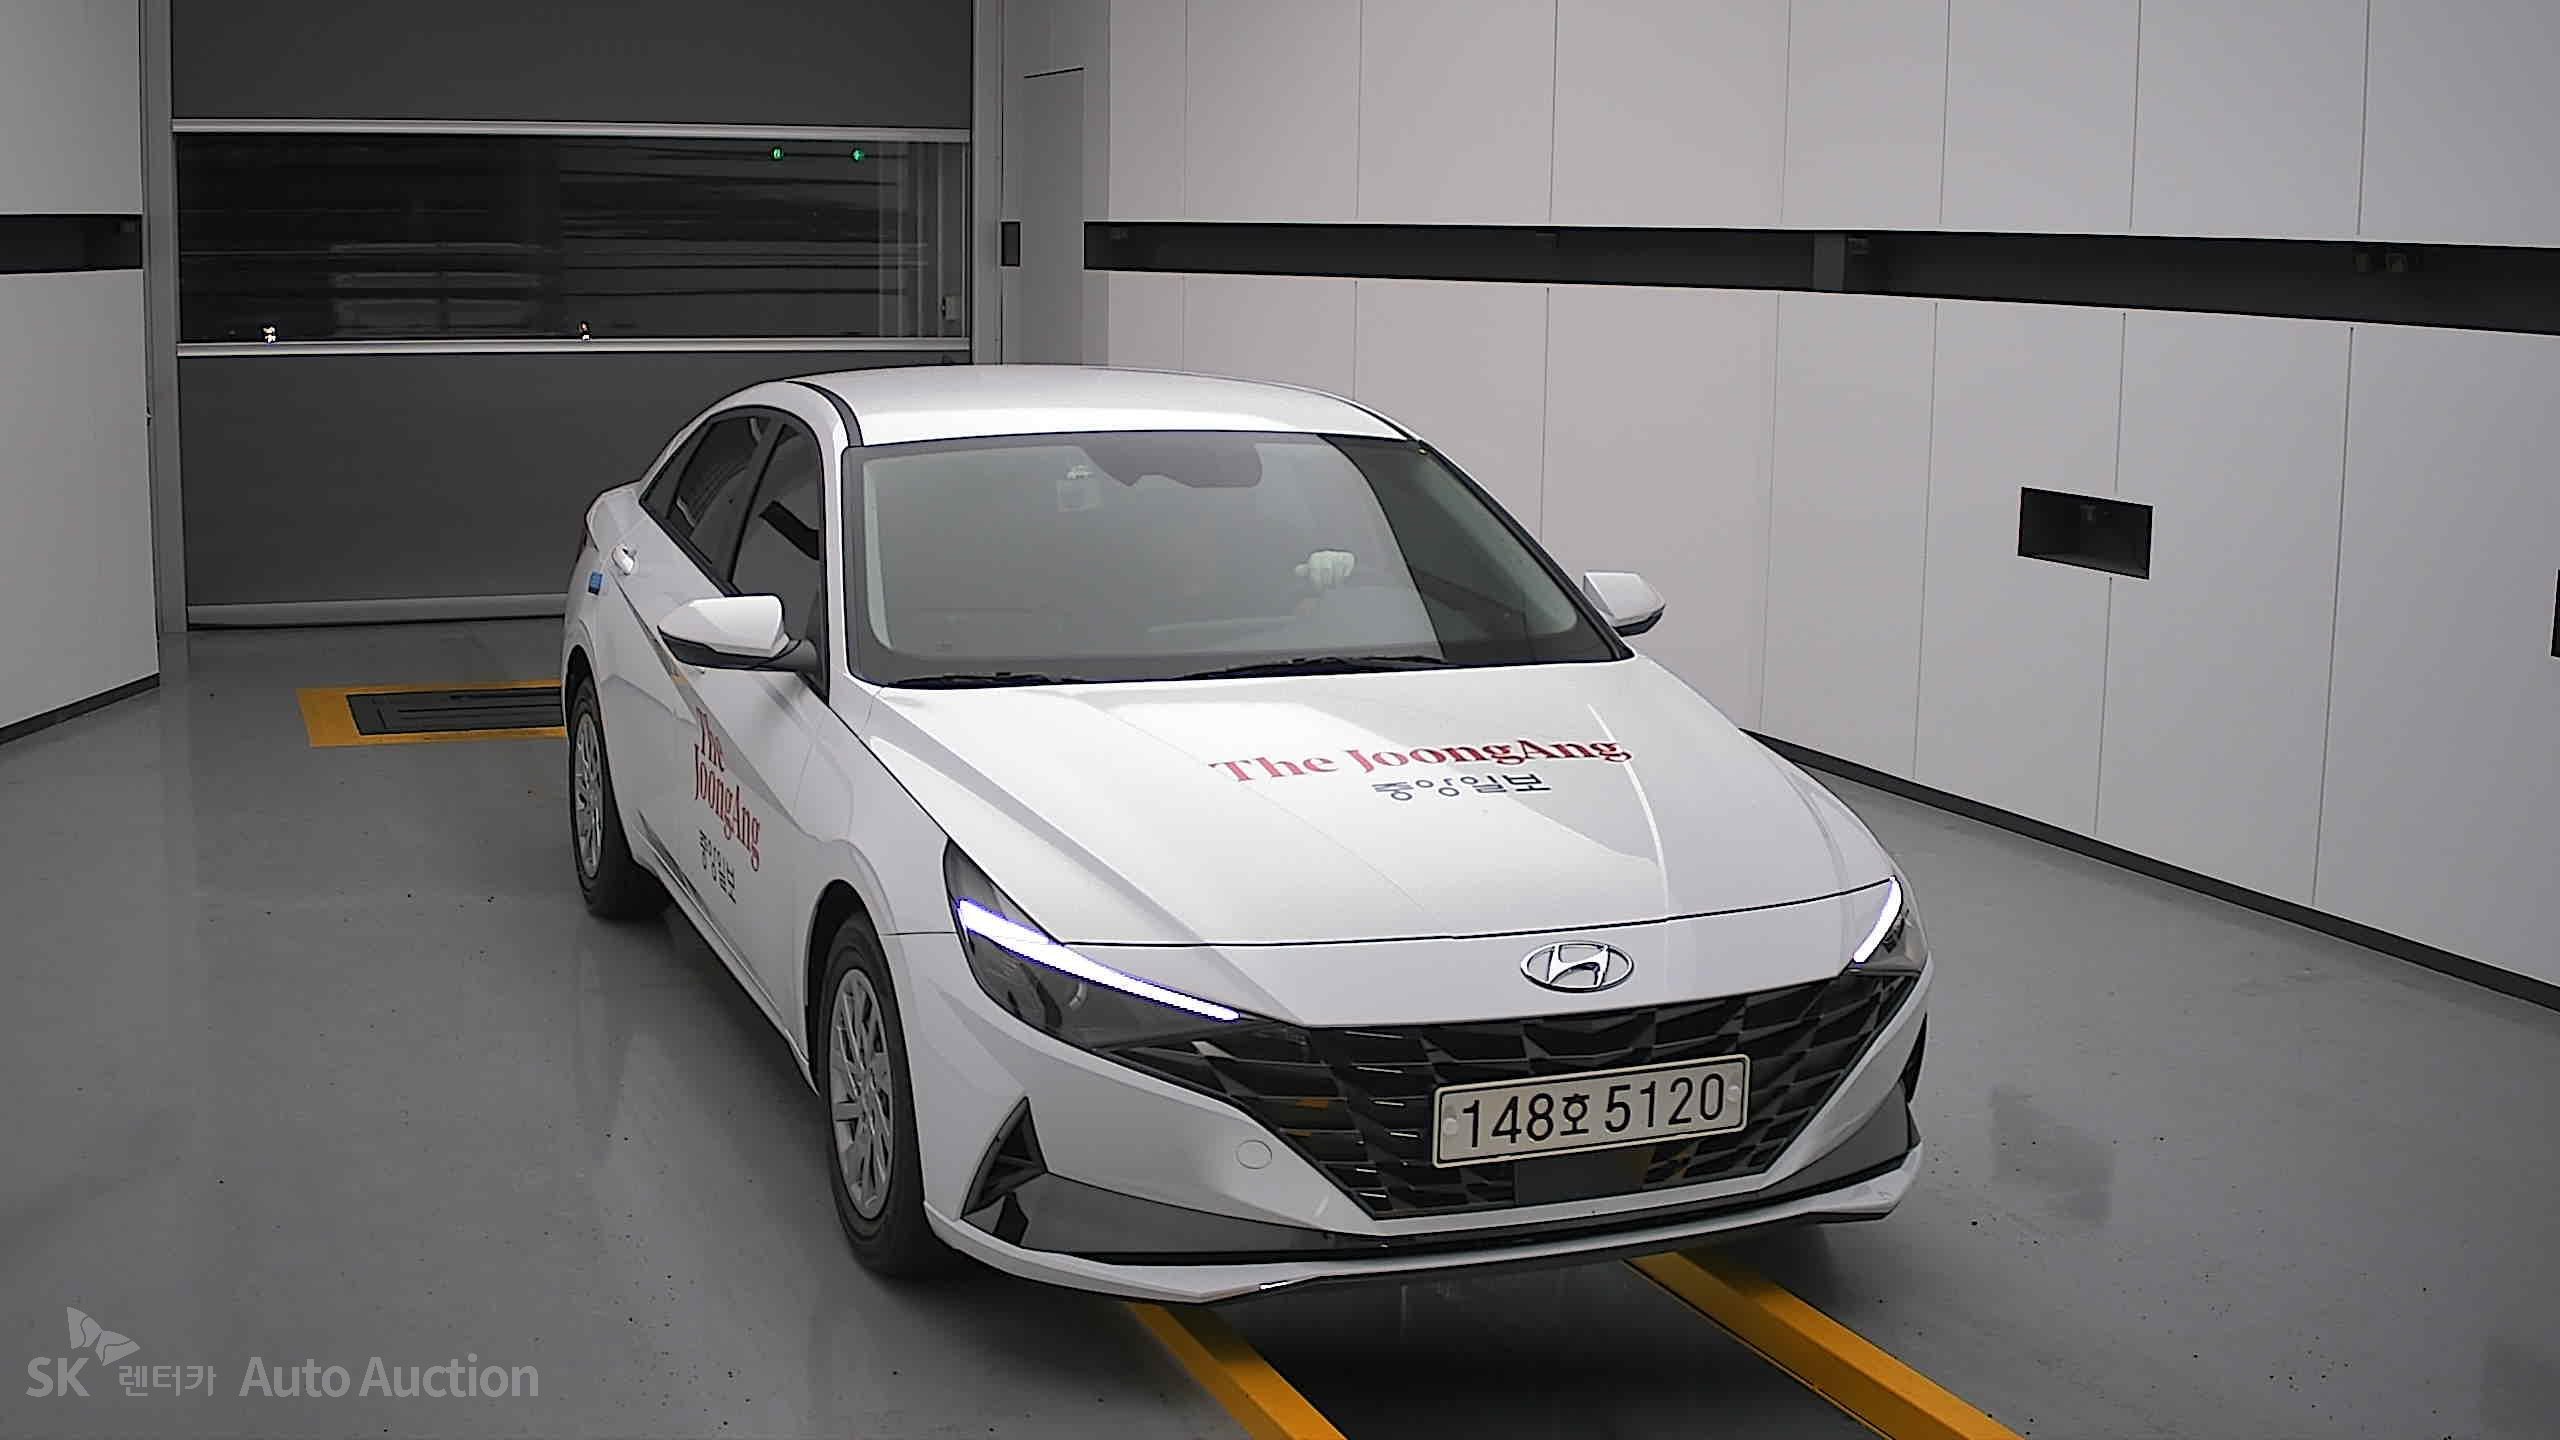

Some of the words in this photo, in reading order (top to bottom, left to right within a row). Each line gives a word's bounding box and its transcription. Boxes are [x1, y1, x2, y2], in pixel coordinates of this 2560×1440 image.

[697, 706, 724, 772] The
[1208, 756, 1338, 783] The
[1346, 737, 1632, 774] JoongAng
[694, 743, 760, 872] JoongAng
[1371, 773, 1551, 801] 중앙일보
[699, 829, 737, 904] 중앙일보
[1462, 1093, 1590, 1149] 148호
[1604, 1073, 1724, 1133] 5120
